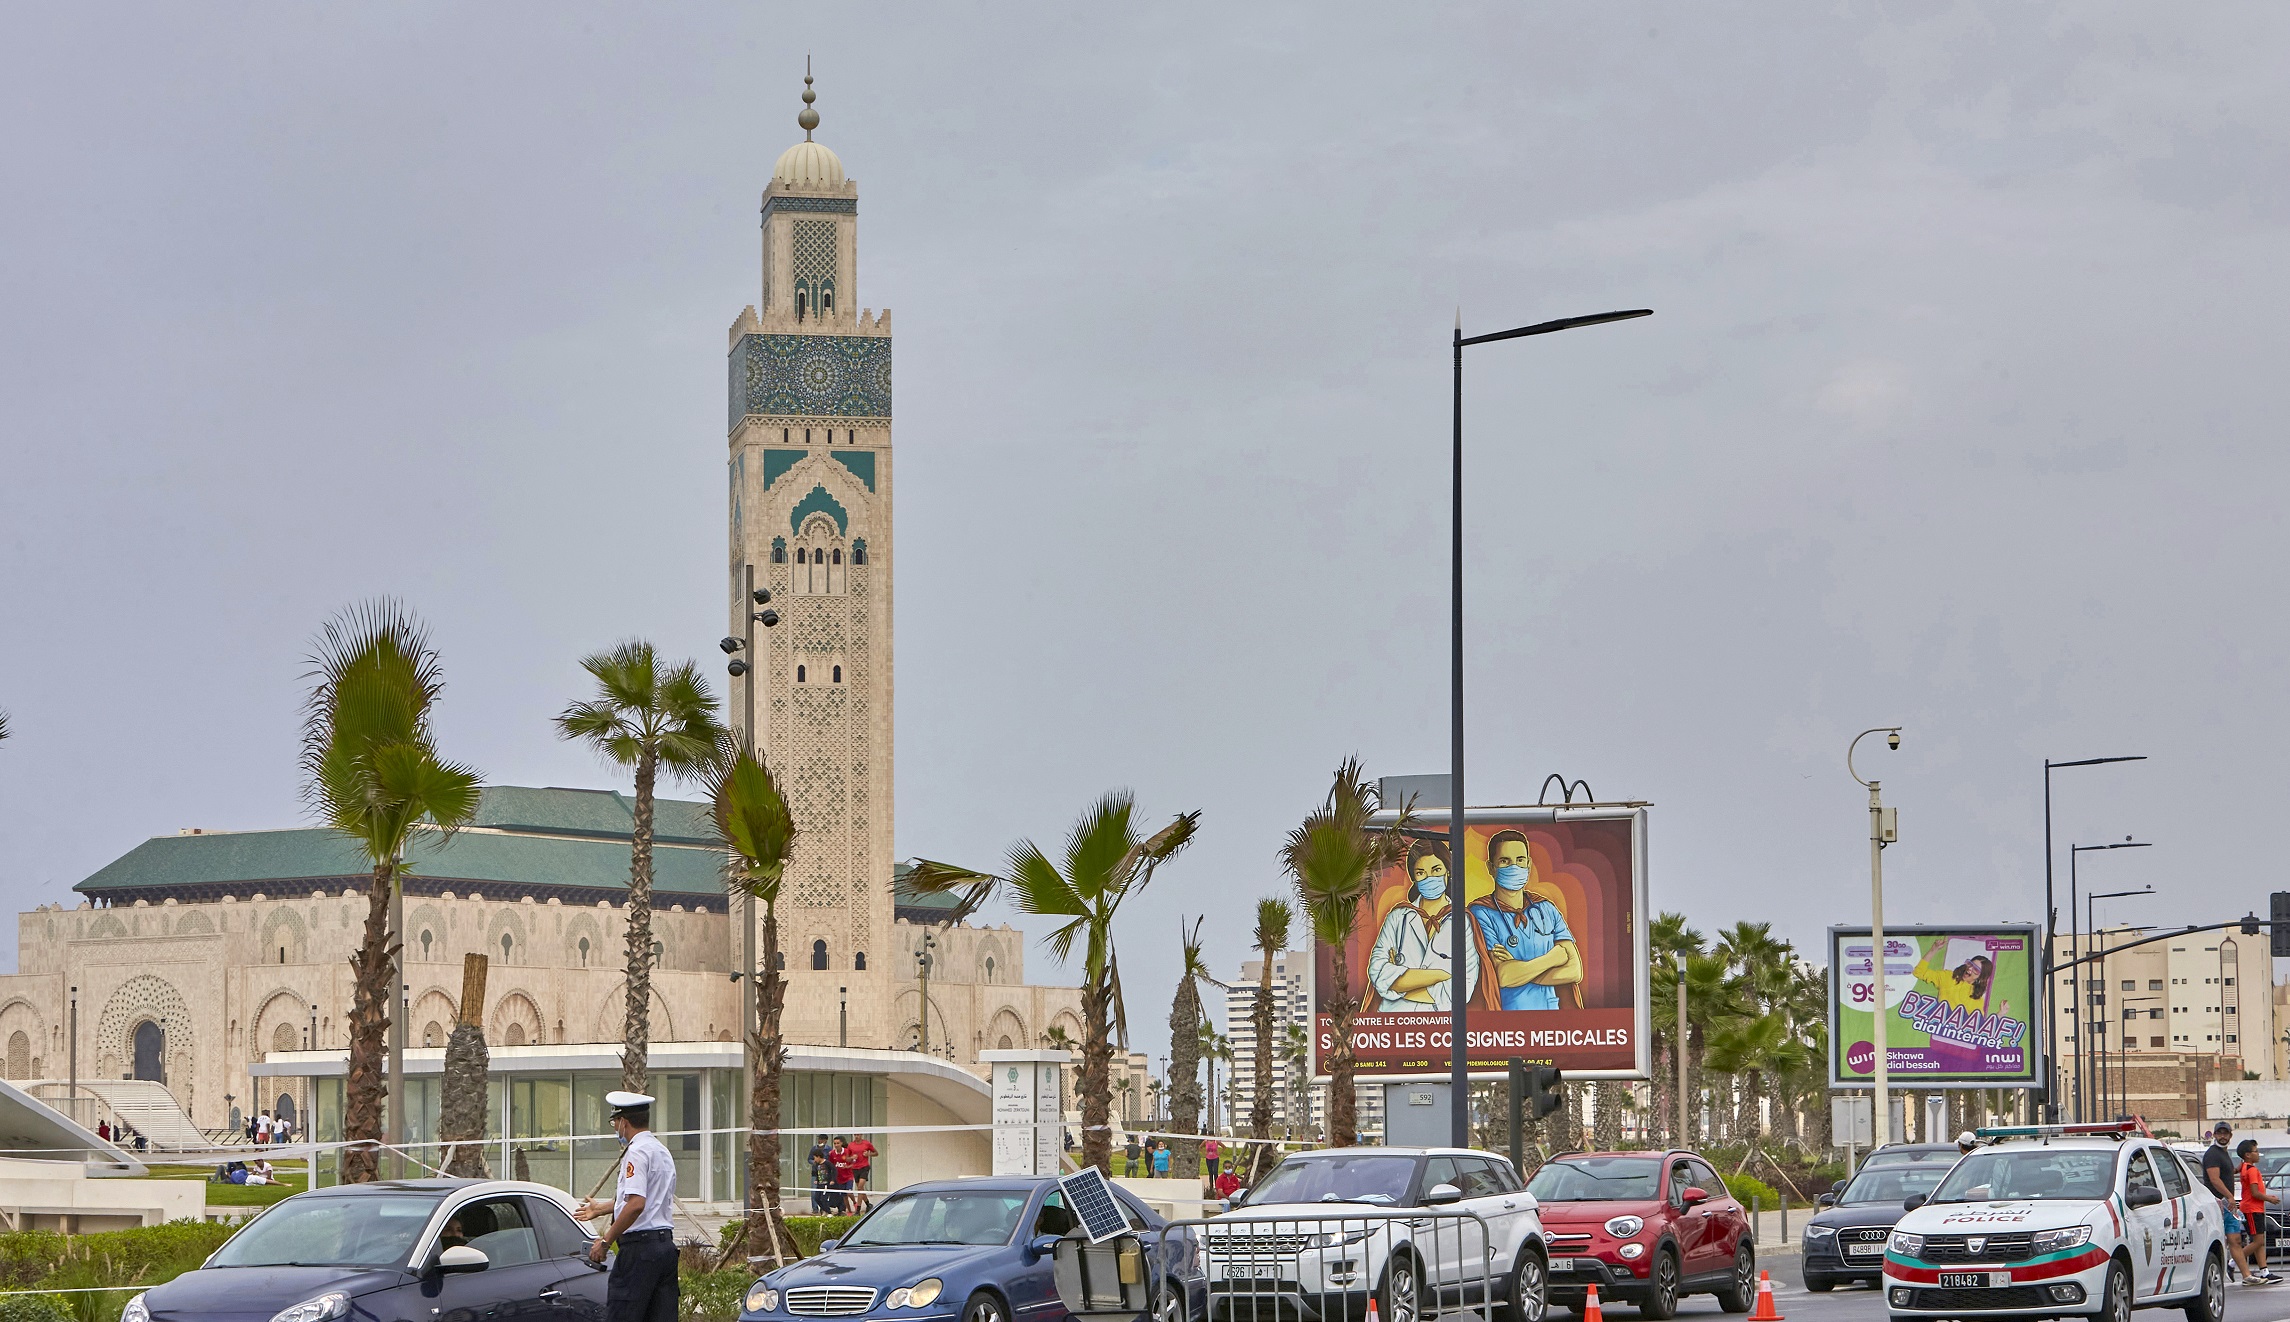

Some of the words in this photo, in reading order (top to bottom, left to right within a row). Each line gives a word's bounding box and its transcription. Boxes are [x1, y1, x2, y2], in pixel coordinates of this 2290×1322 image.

[1352, 1016, 1382, 1026] ONTRE
[1384, 1017, 1395, 1026] LE
[1899, 991, 2026, 1047] BZAAAAF!
[1395, 1032, 1426, 1048] LES
[1430, 1031, 1526, 1048] COSIGNES
[1530, 1028, 1628, 1046] MEDICALES
[1912, 1020, 1942, 1036] dial
[1944, 1024, 2004, 1050] internet
[1886, 1052, 1924, 1060] Skhawa
[1986, 1054, 2020, 1062] inwi
[1886, 1061, 1904, 1069] dial
[1906, 1061, 1940, 1069] bessah
[1942, 1216, 2026, 1224] POLICE
[1566, 1260, 1572, 1270] 6
[1943, 1274, 1978, 1287] 218482
